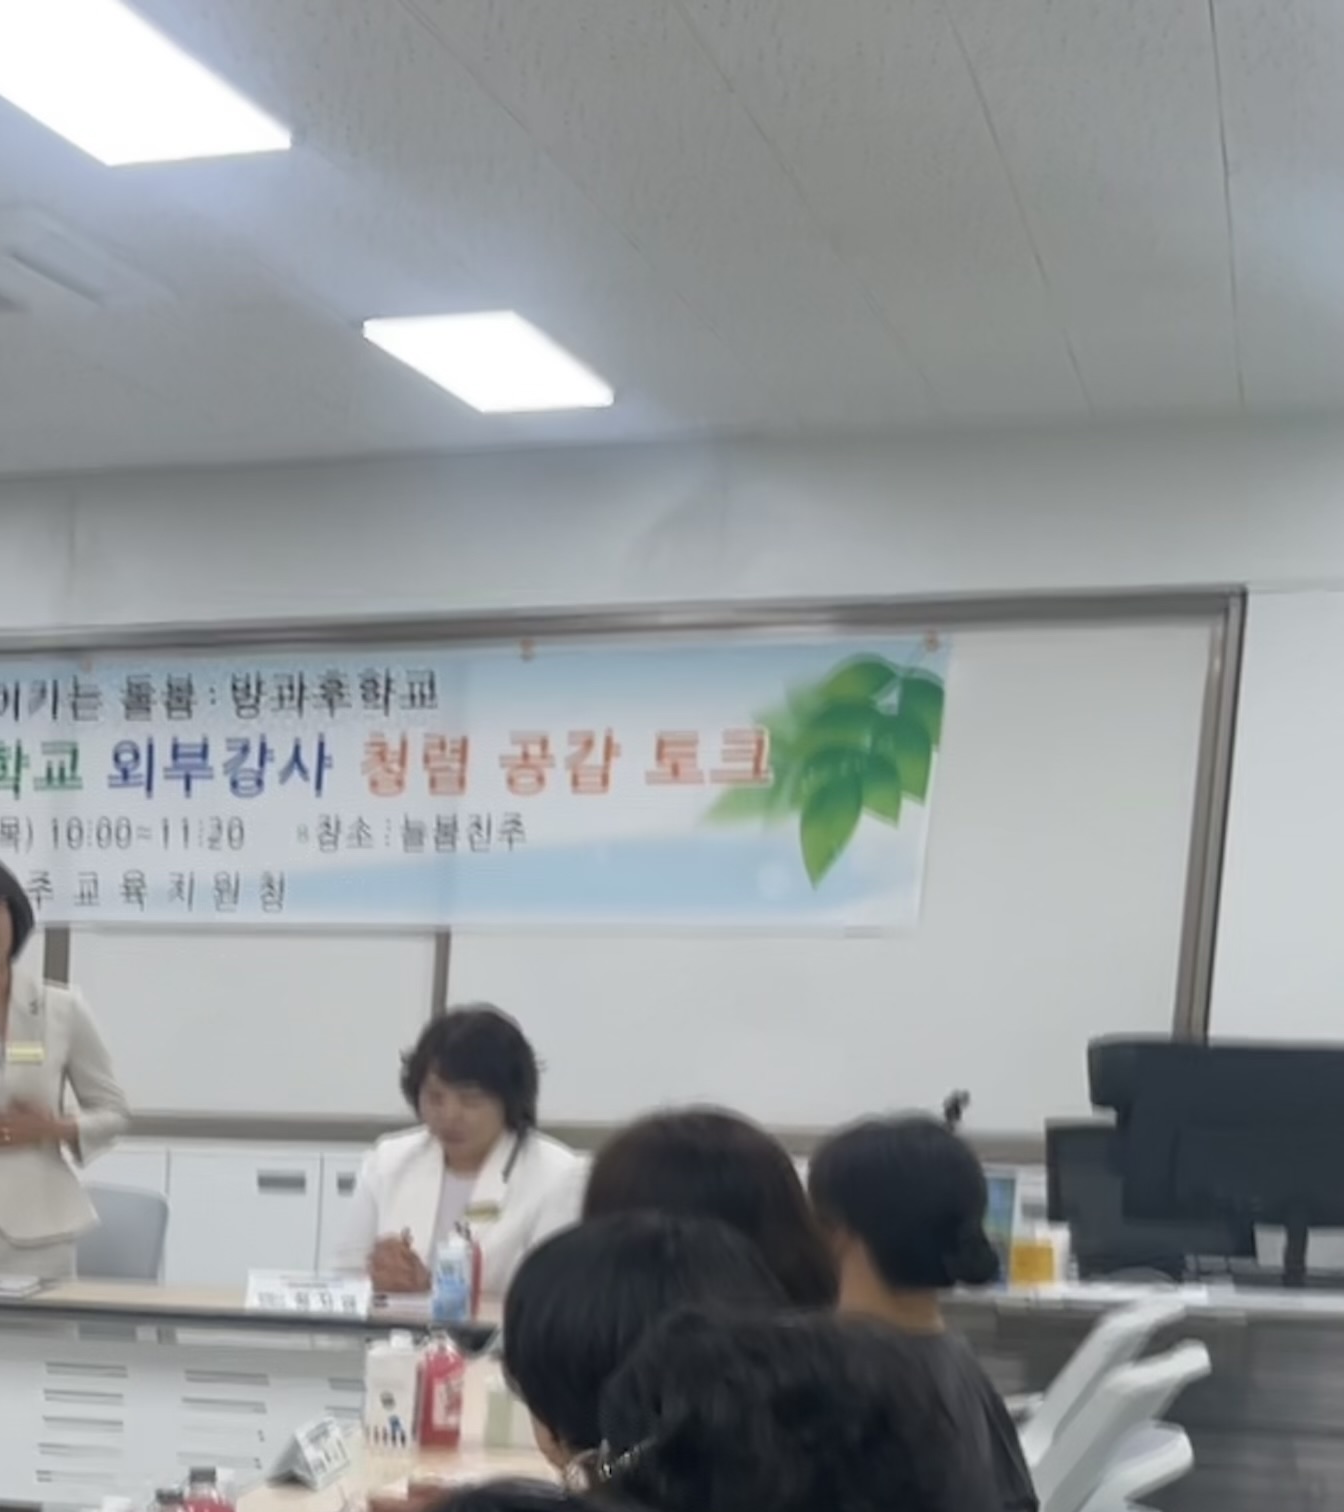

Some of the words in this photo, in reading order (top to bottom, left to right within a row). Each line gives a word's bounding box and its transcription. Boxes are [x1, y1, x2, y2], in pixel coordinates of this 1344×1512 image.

[107, 732, 334, 800] 외부강사
[361, 730, 470, 797] 청렴
[498, 727, 622, 796] 공감
[644, 726, 774, 787] 토크
